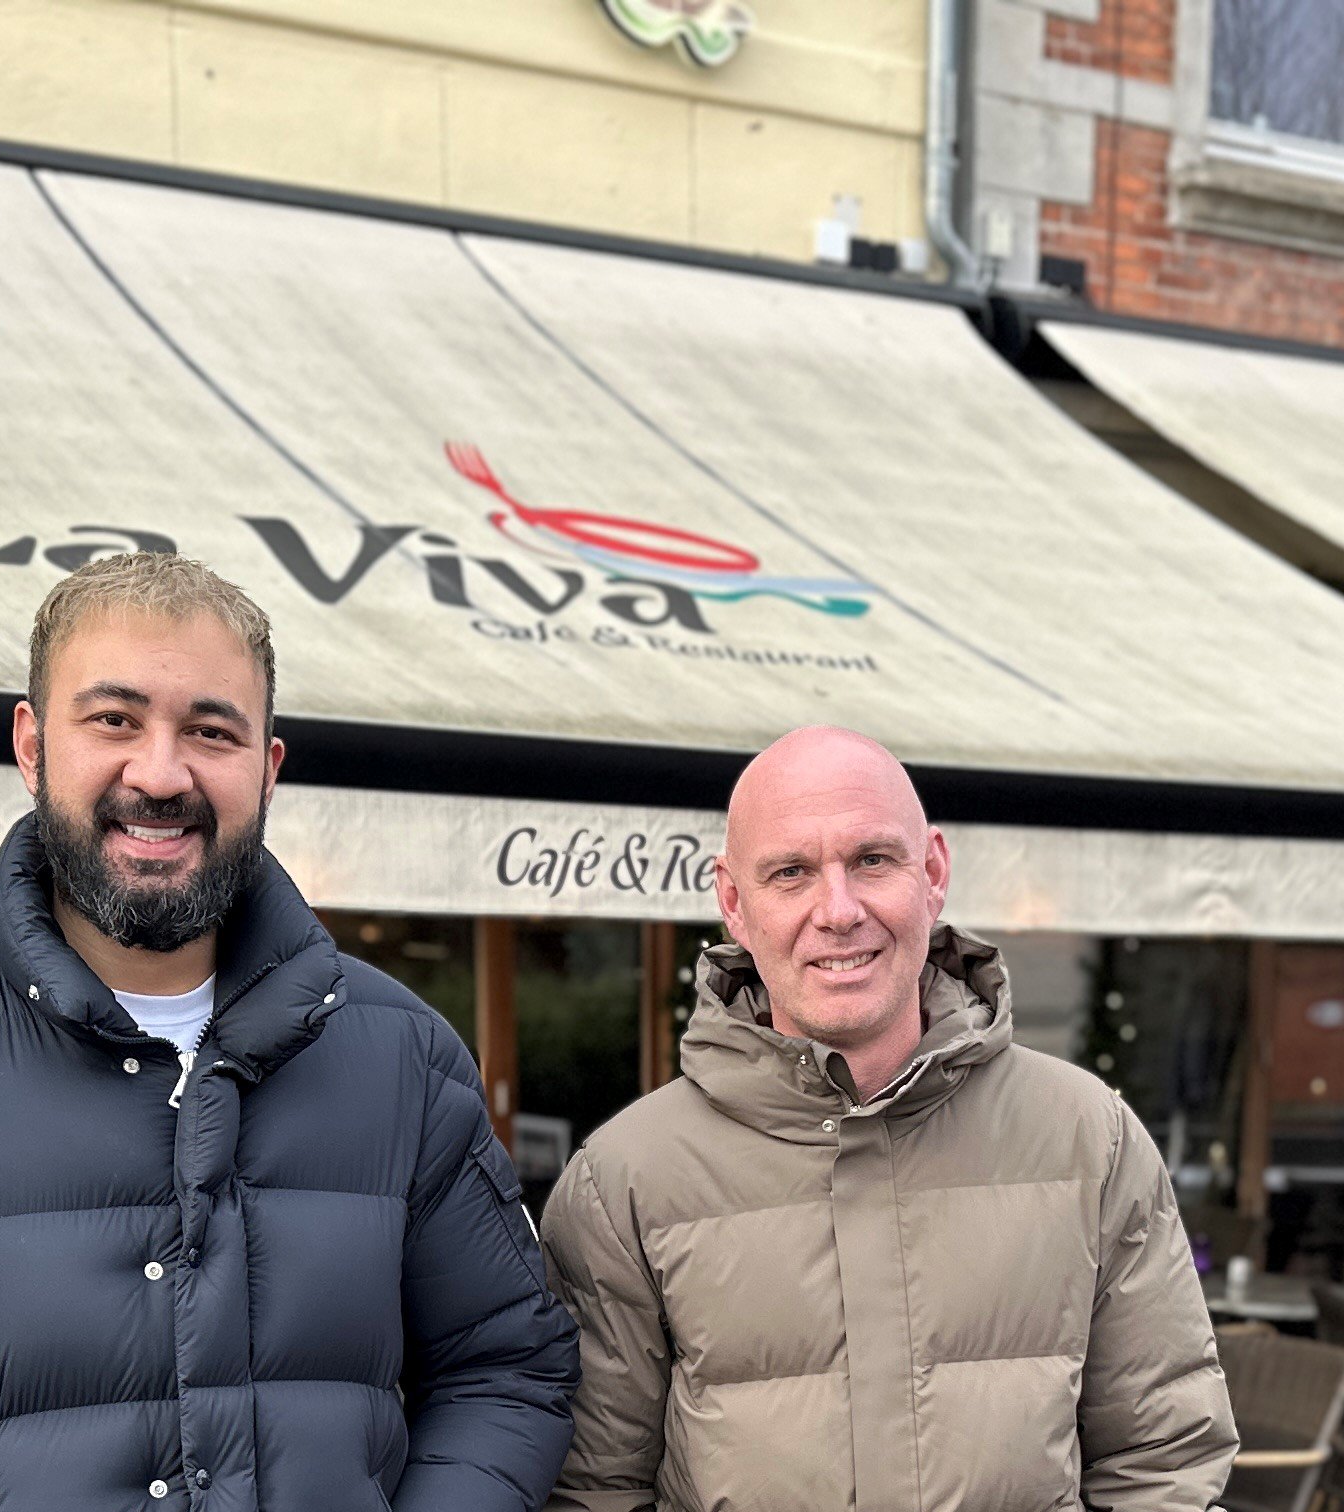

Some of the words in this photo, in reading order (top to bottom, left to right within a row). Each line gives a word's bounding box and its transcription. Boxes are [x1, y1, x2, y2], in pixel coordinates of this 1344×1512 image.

[236, 515, 716, 635] Viva
[591, 624, 634, 648] &
[646, 634, 879, 673] Restaurant
[496, 827, 602, 898] Café
[609, 833, 650, 895] &
